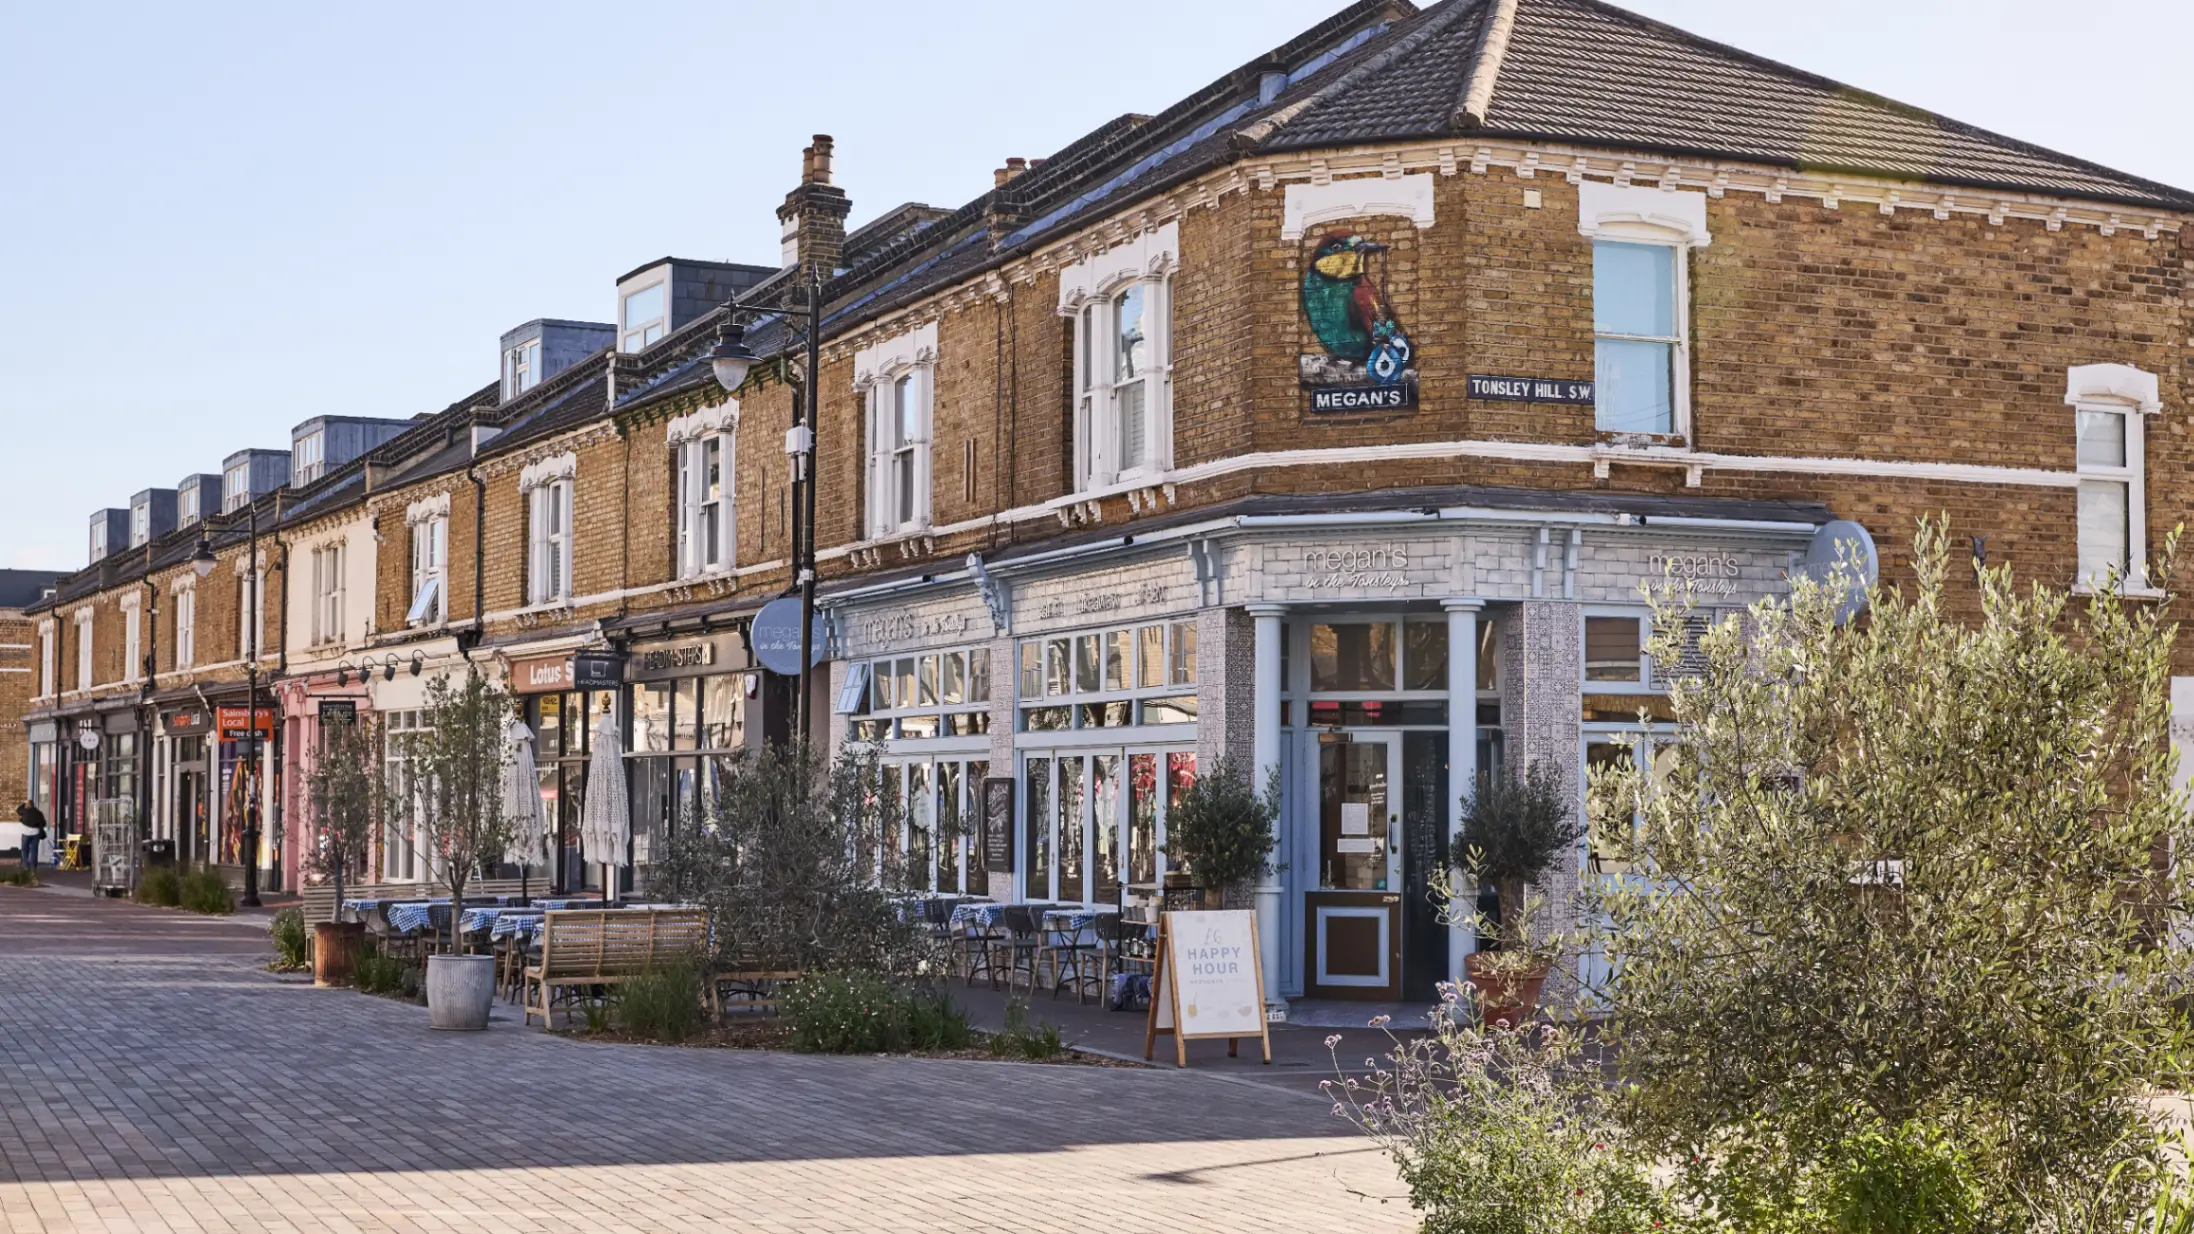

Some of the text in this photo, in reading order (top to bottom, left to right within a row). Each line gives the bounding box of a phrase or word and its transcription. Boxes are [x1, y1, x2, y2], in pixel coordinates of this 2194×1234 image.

[1472, 379, 1530, 397] TONSLEY
[1316, 390, 1401, 408] MEGAN'S
[1304, 543, 1408, 575] megan's
[1650, 552, 1738, 580] megan's
[1306, 577, 1319, 589] in
[1324, 572, 1344, 588] the
[1691, 579, 1737, 599] Tonsleys
[760, 626, 820, 642] megas
[771, 640, 784, 650] the
[787, 641, 820, 654] Tonys
[530, 663, 561, 685] Lotus
[577, 679, 619, 687] HEADMASTERS
[222, 718, 245, 727] Local
[1187, 947, 1241, 960] HAPPY
[1192, 962, 1238, 975] HOUR
